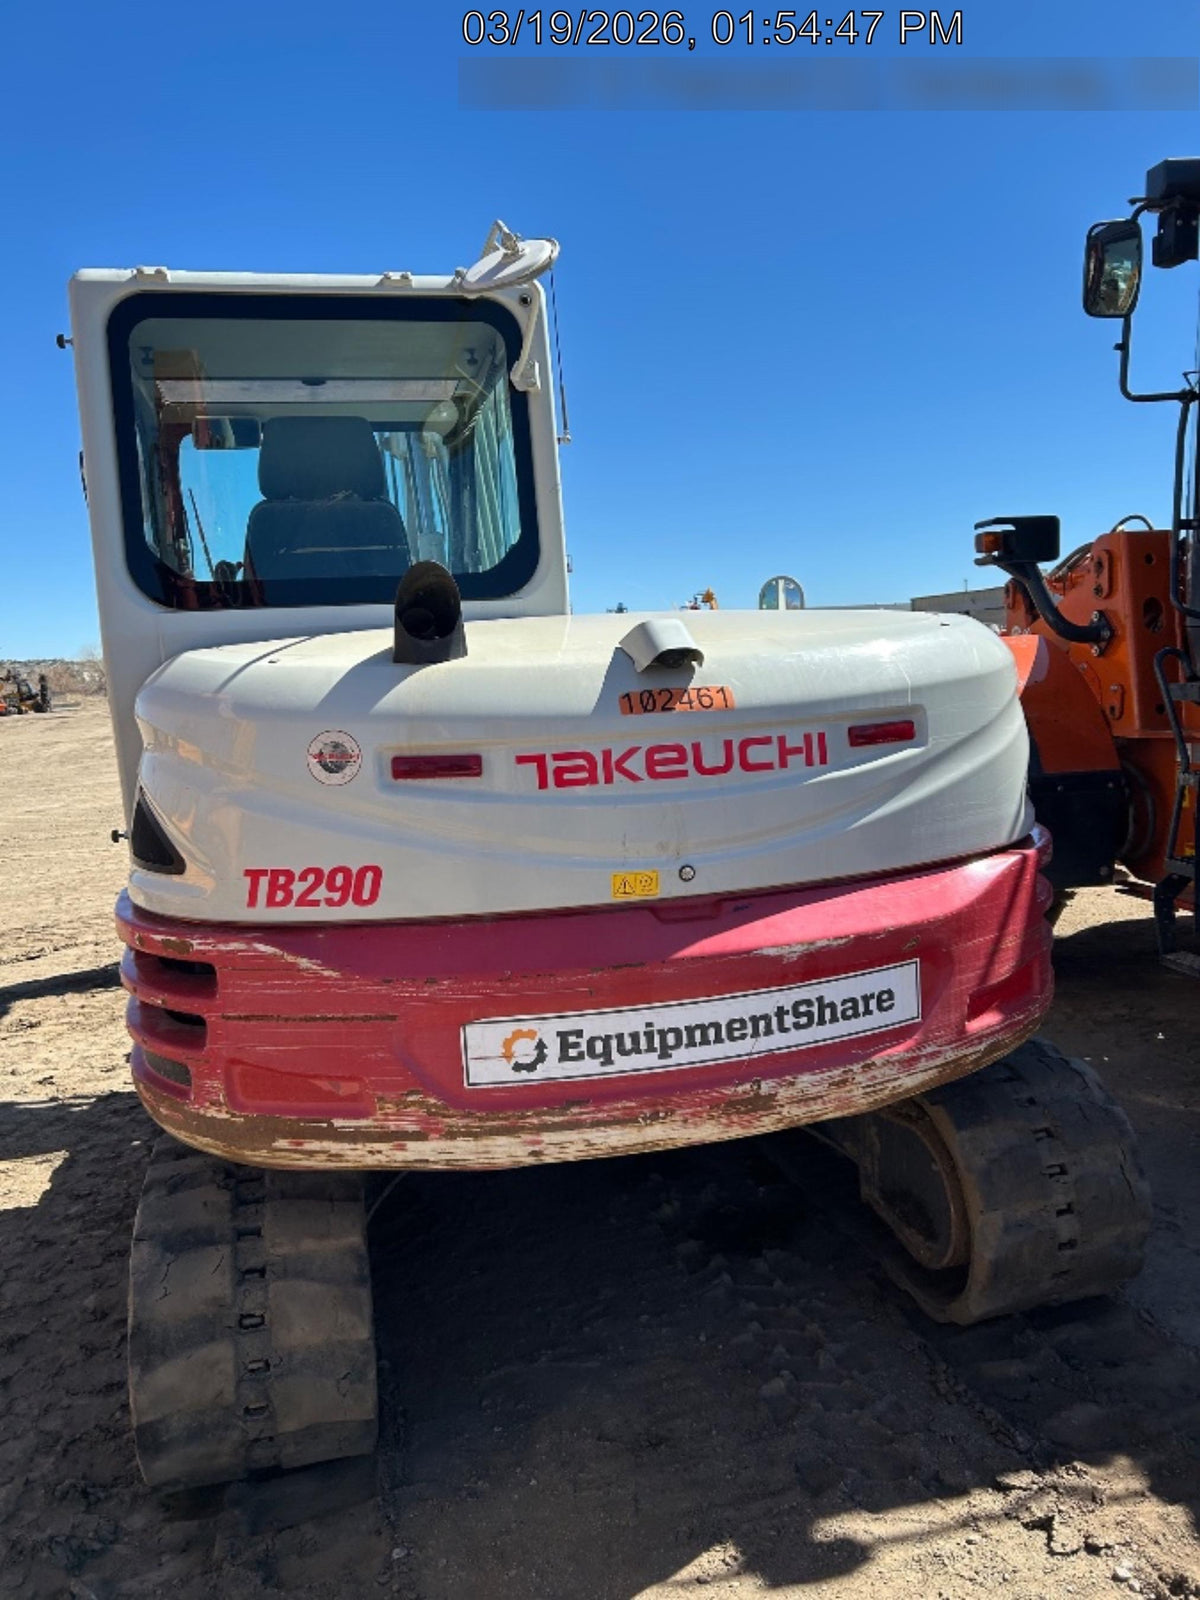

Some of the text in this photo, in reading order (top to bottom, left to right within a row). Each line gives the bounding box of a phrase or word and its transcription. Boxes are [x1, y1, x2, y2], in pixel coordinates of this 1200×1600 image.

[622, 686, 731, 714] 102461
[243, 865, 383, 909] TB290
[557, 987, 895, 1064] EquipmentShare
